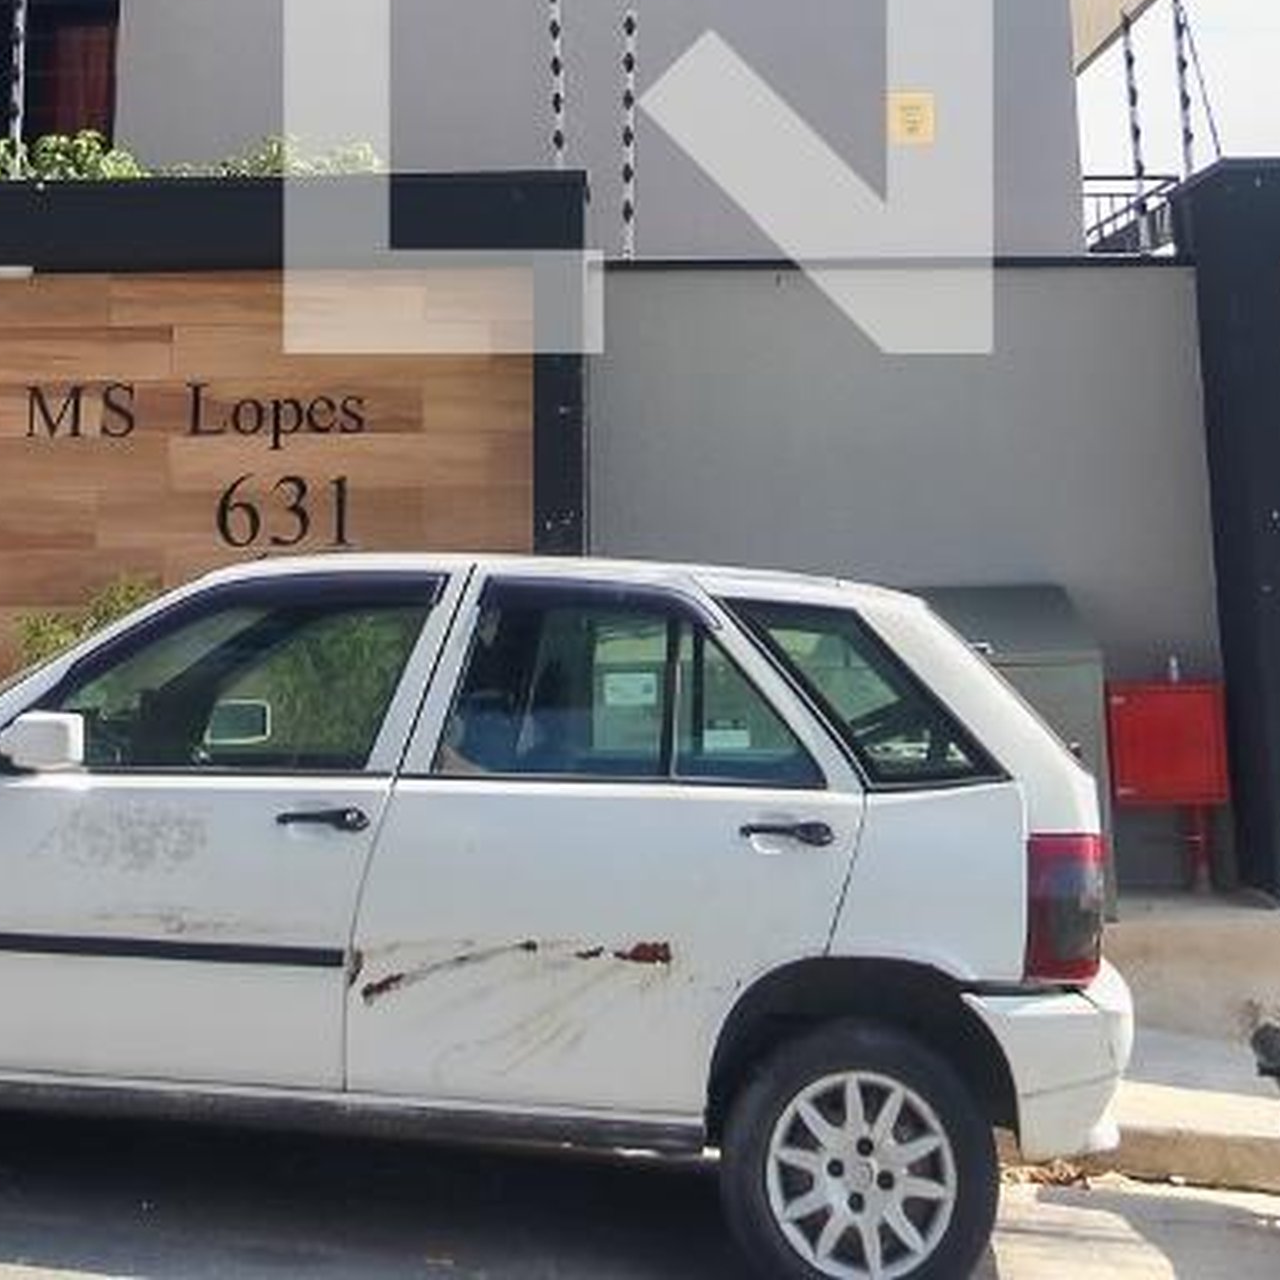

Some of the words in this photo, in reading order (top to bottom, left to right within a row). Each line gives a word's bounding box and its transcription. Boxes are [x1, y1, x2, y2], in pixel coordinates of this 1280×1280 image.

[25, 382, 136, 438] MS
[186, 382, 366, 450] Lopes
[216, 472, 352, 548] 631
